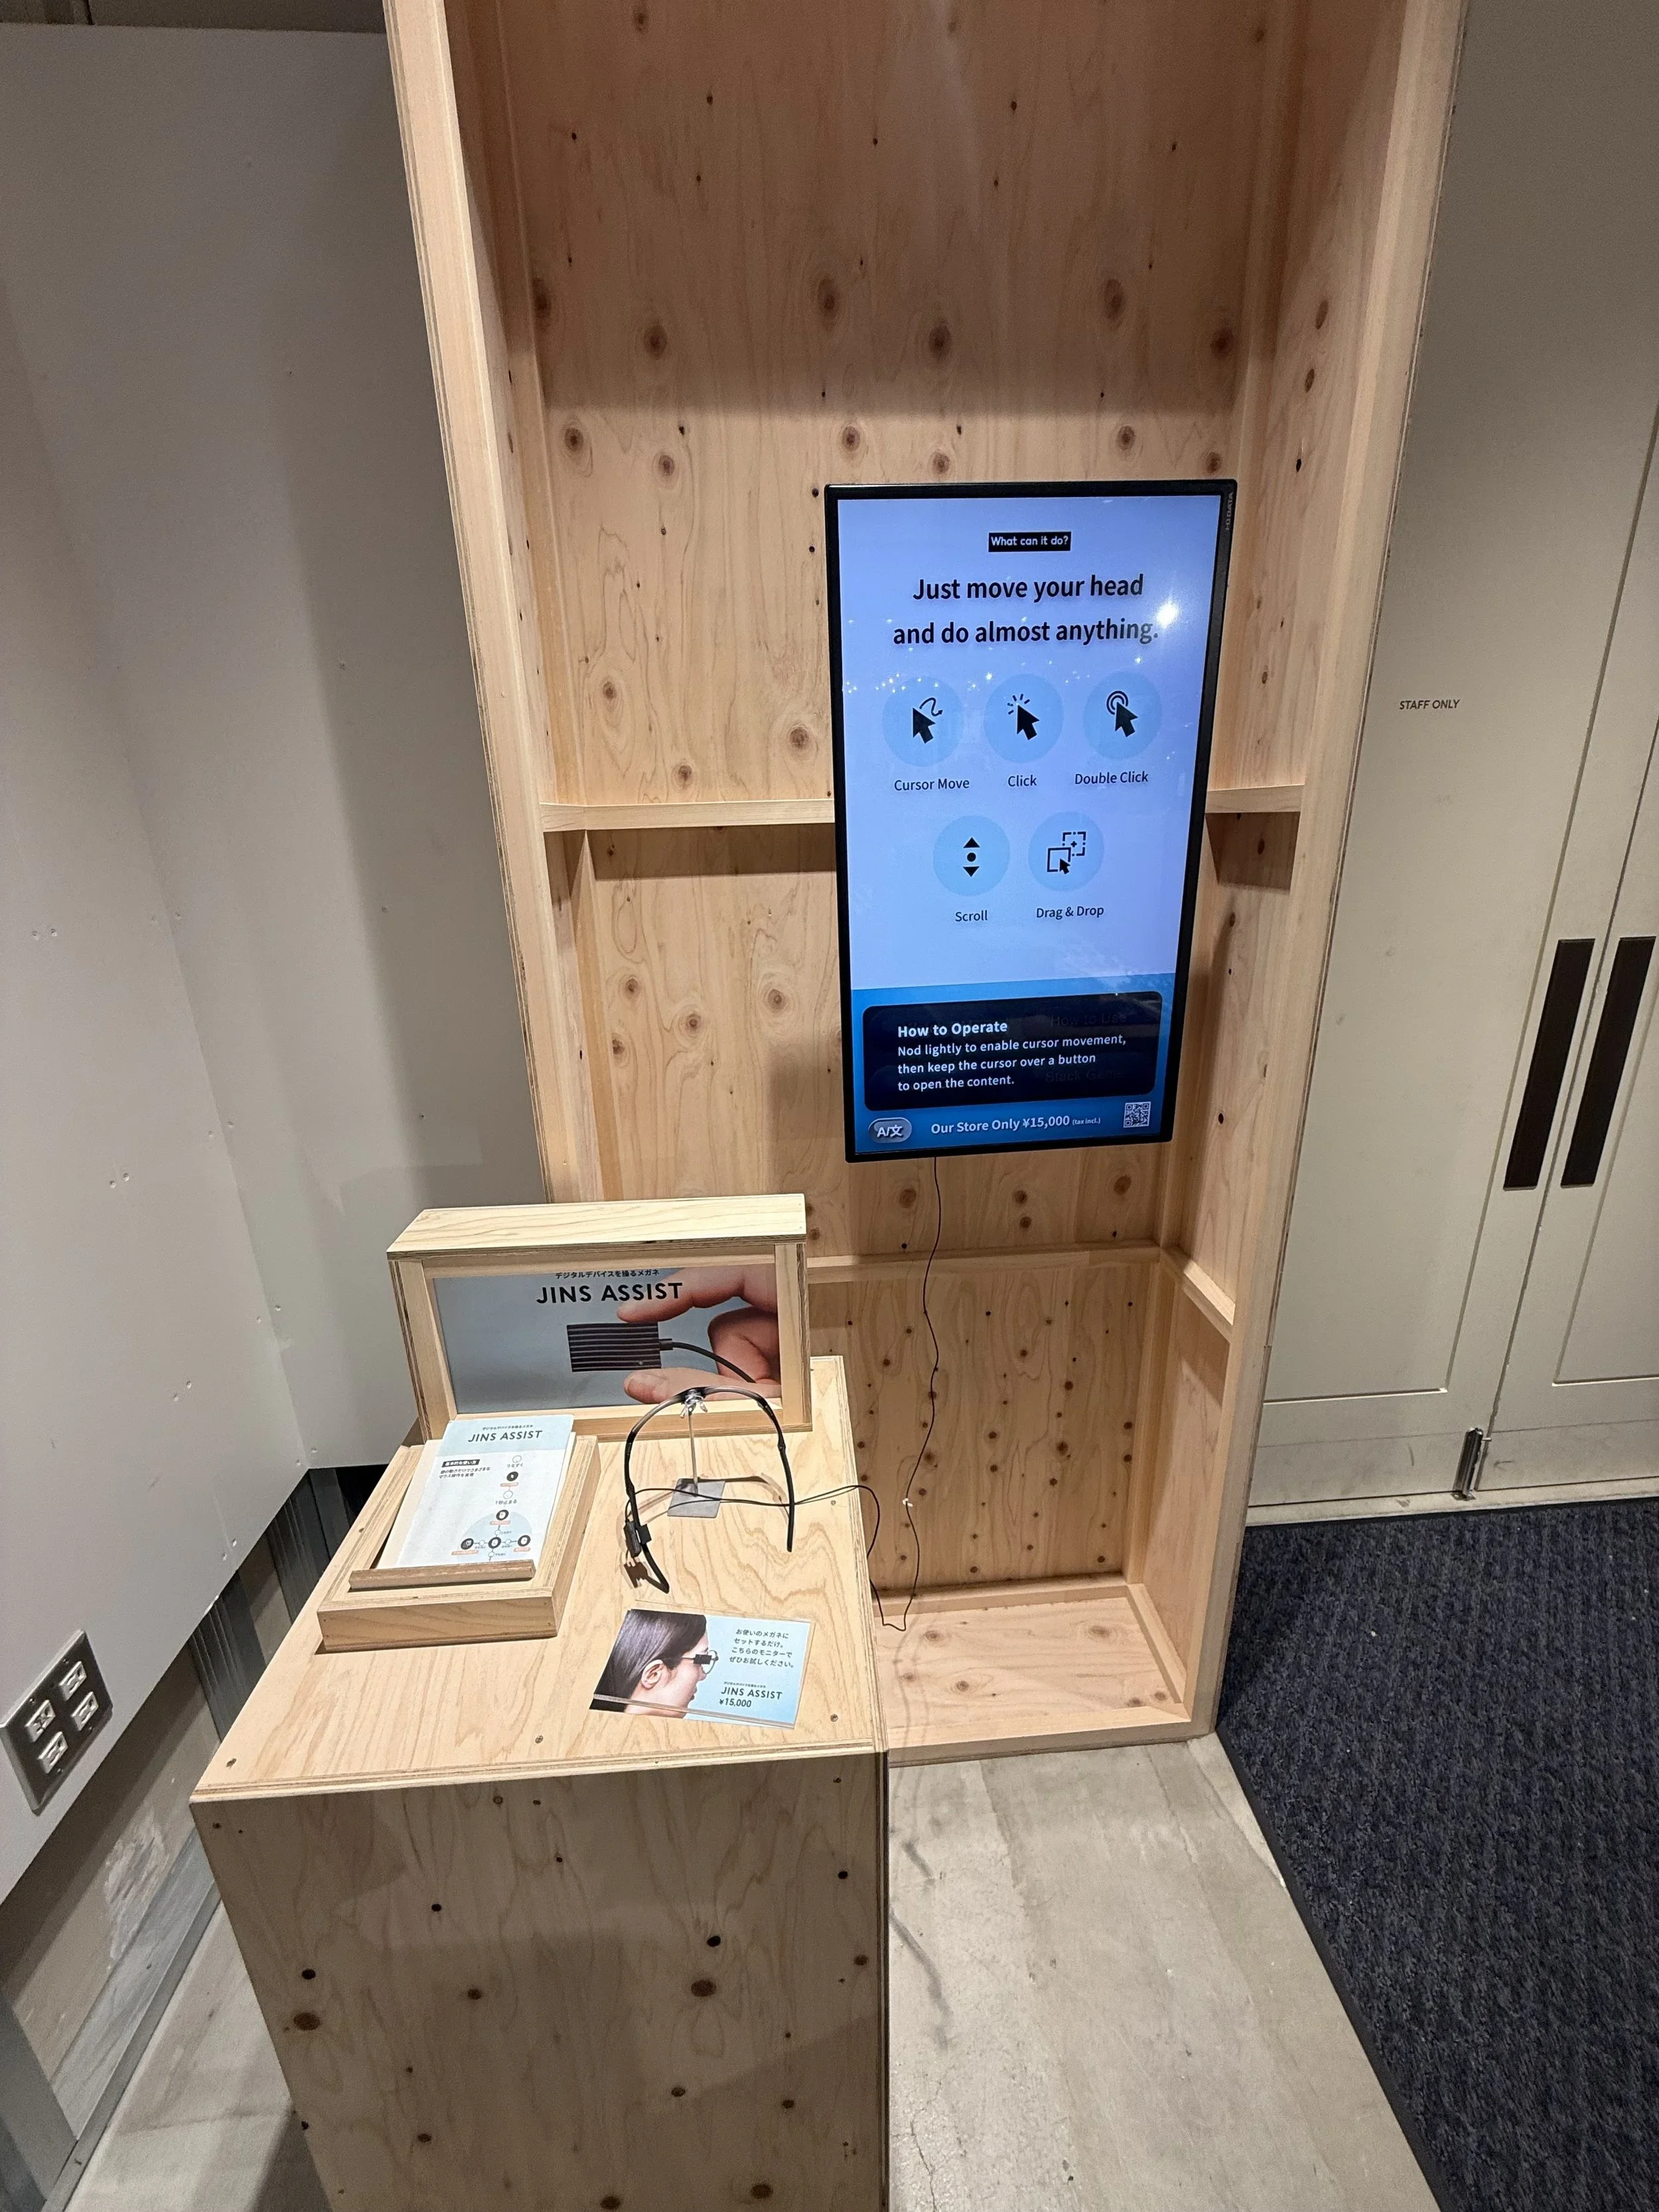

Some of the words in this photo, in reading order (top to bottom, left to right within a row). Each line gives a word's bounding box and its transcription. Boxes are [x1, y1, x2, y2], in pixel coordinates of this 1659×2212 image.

[991, 536, 1017, 546] What
[1041, 536, 1048, 545] it
[1050, 536, 1068, 545] do?
[913, 579, 960, 600] Just
[967, 581, 1027, 599] move
[1034, 580, 1084, 603] your
[1090, 573, 1143, 596] head
[893, 622, 934, 644] and
[941, 622, 969, 643] do
[975, 621, 1050, 642] almost
[1056, 618, 1158, 644] anything.
[1399, 700, 1430, 709] STAFF
[1432, 699, 1460, 709] ONLY
[894, 779, 934, 791] Cursor
[937, 778, 970, 790] Move
[1007, 774, 1037, 787] Click
[1074, 771, 1118, 785] Double
[1119, 771, 1149, 784] Click
[955, 910, 988, 922] Scroll
[1036, 907, 1063, 920] Drag
[1066, 907, 1074, 917] &
[1076, 905, 1104, 918] Drop
[898, 1026, 929, 1038] How
[932, 1025, 948, 1036] to
[951, 1021, 1007, 1037] Operate
[898, 1044, 921, 1056] Nod
[925, 1043, 962, 1057] lightly
[965, 1043, 977, 1053] to
[979, 1040, 1019, 1052] enable
[1023, 1039, 1059, 1049] cursor
[1062, 1034, 1126, 1047] movement,
[898, 1063, 924, 1074] then
[928, 1062, 955, 1074] keep
[958, 1060, 977, 1071] the
[980, 1059, 1016, 1069] cursor
[1020, 1058, 1045, 1067] over
[1058, 1054, 1096, 1065] button
[898, 1081, 909, 1091] to
[913, 1080, 942, 1092] open
[945, 1077, 964, 1088] the
[967, 1075, 1015, 1087] content.
[931, 1123, 954, 1134] Our
[956, 1121, 988, 1133] Store
[991, 1118, 1020, 1132] Only
[1023, 1116, 1070, 1129] ¥15,000
[555, 1269, 660, 1279] デジタルデバイスを操るメガネ
[536, 1286, 592, 1304] JINS
[601, 1282, 683, 1301] ASSIST
[468, 1433, 496, 1443] JINS
[500, 1430, 543, 1440] ASSIST
[736, 1629, 789, 1639] お使いのメガネに
[734, 1637, 784, 1648] セットするだけ。
[731, 1647, 792, 1658] こちらのモニターで
[729, 1657, 794, 1668] ぜひお試しください。
[721, 1686, 745, 1696] JINS
[747, 1689, 782, 1700] ASSIST
[719, 1698, 752, 1708] ¥15,000
